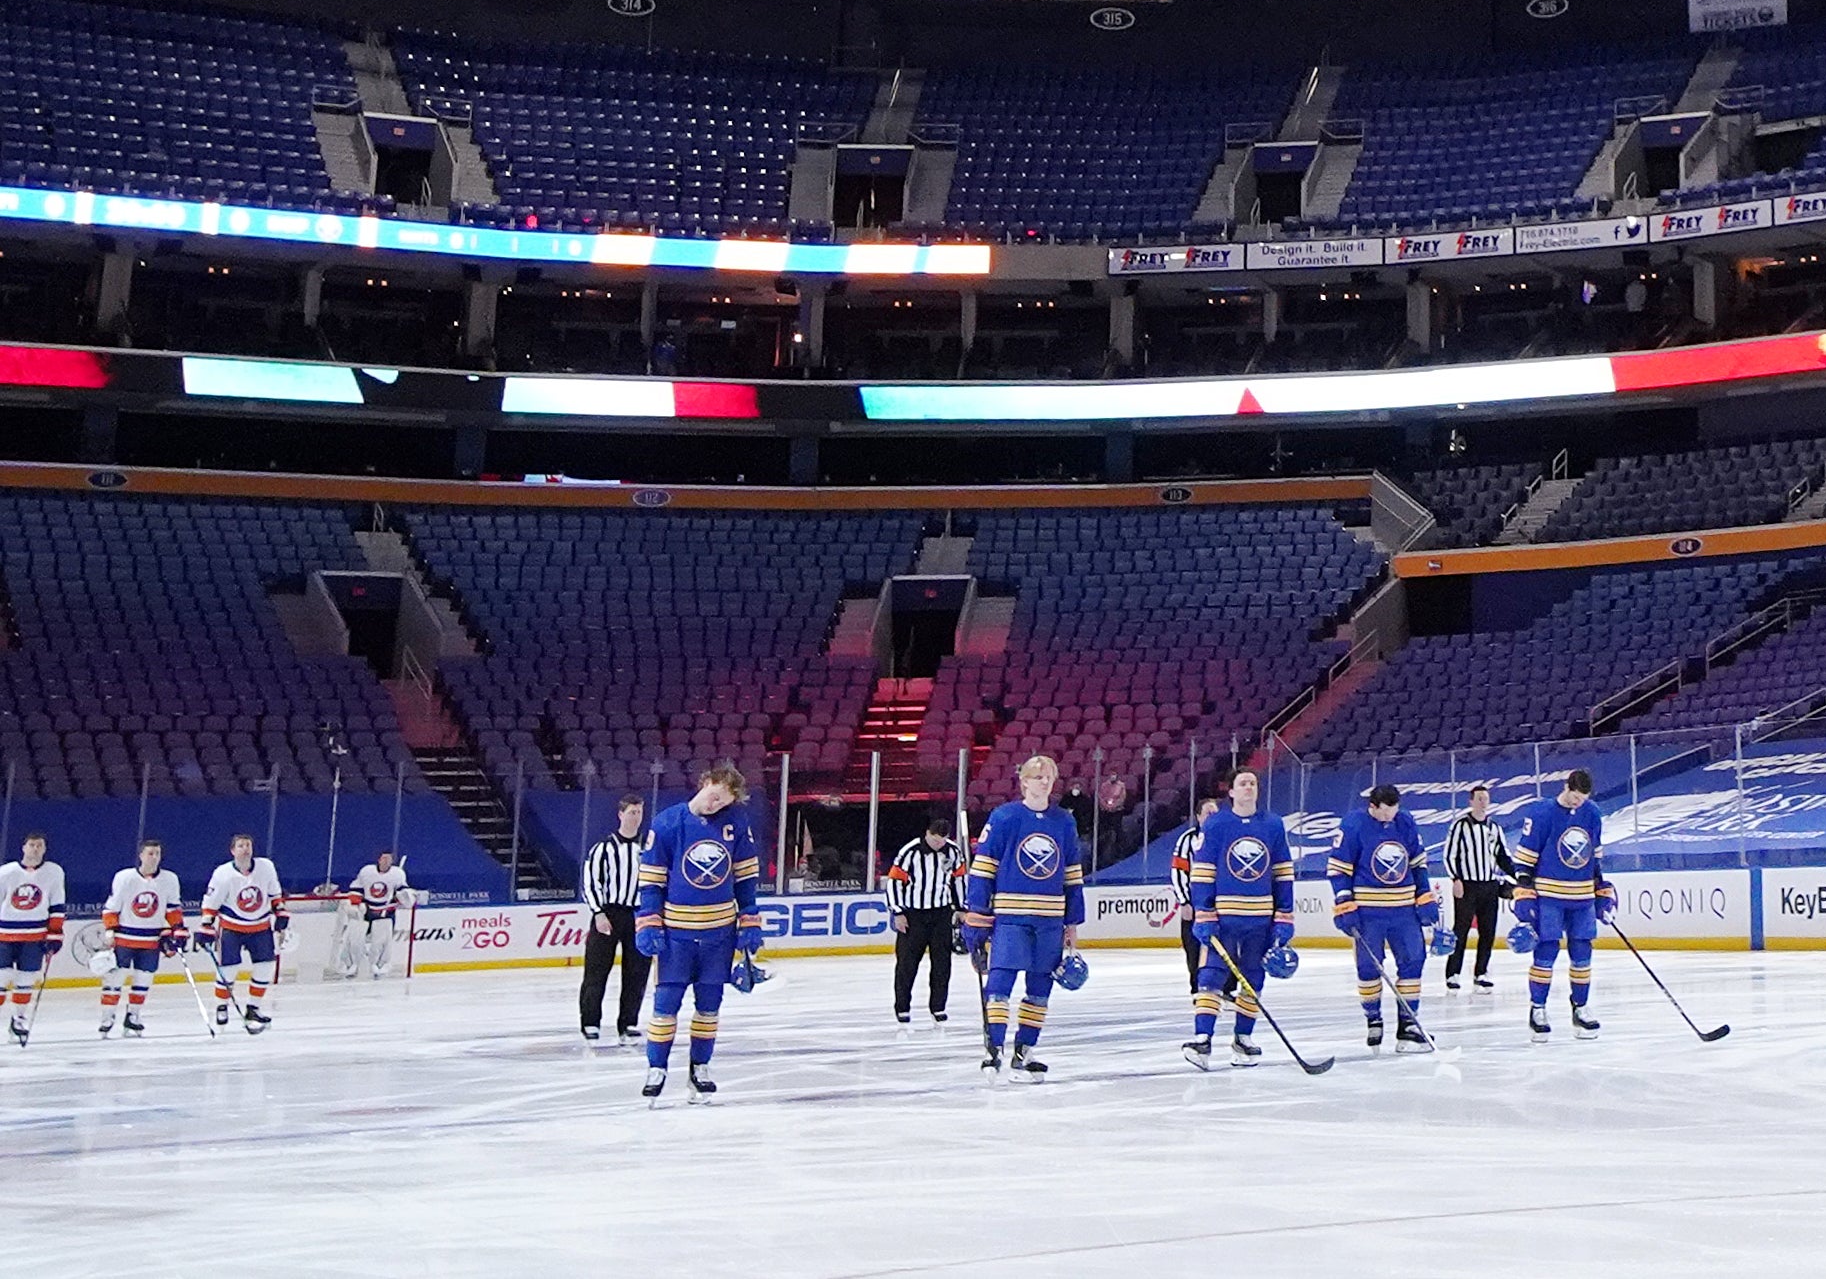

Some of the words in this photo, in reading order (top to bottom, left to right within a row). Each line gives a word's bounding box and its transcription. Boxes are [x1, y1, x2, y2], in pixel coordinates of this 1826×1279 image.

[1102, 11, 1123, 26] 315
[1669, 215, 1703, 229] FREY
[1723, 208, 1759, 223] FREY
[1261, 244, 1304, 257] Design
[1323, 241, 1355, 254] Build
[1404, 240, 1441, 254] FREY
[1463, 235, 1500, 249] FREY
[1129, 251, 1168, 266] FREY
[1192, 248, 1232, 263] FREY
[1277, 256, 1338, 266] Guarantee
[722, 824, 734, 841] C
[1098, 897, 1169, 920] premcom
[1626, 887, 1727, 920] IQONIQ
[462, 912, 512, 929] meals
[757, 900, 894, 938] GEIC
[461, 931, 511, 950] 2GO
